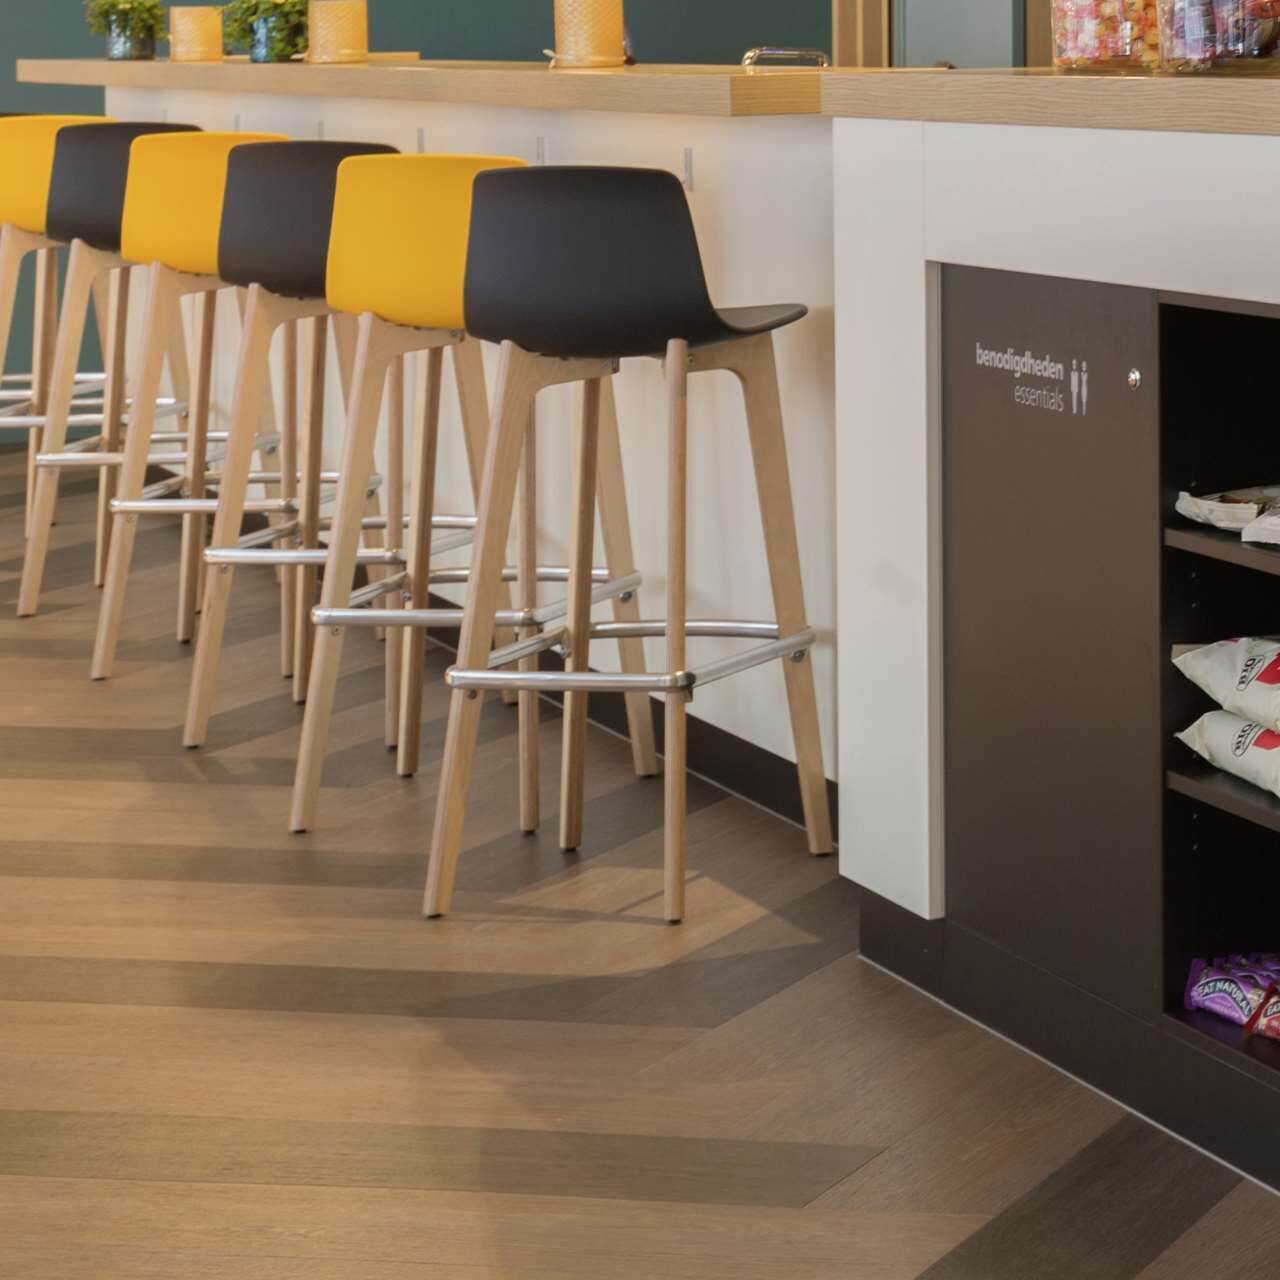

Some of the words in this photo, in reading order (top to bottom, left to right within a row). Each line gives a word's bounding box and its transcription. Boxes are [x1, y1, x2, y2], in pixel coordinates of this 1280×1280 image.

[975, 342, 1064, 380] benodigdheden
[1014, 384, 1064, 412] essentials
[1216, 980, 1250, 1017] NATURAL
